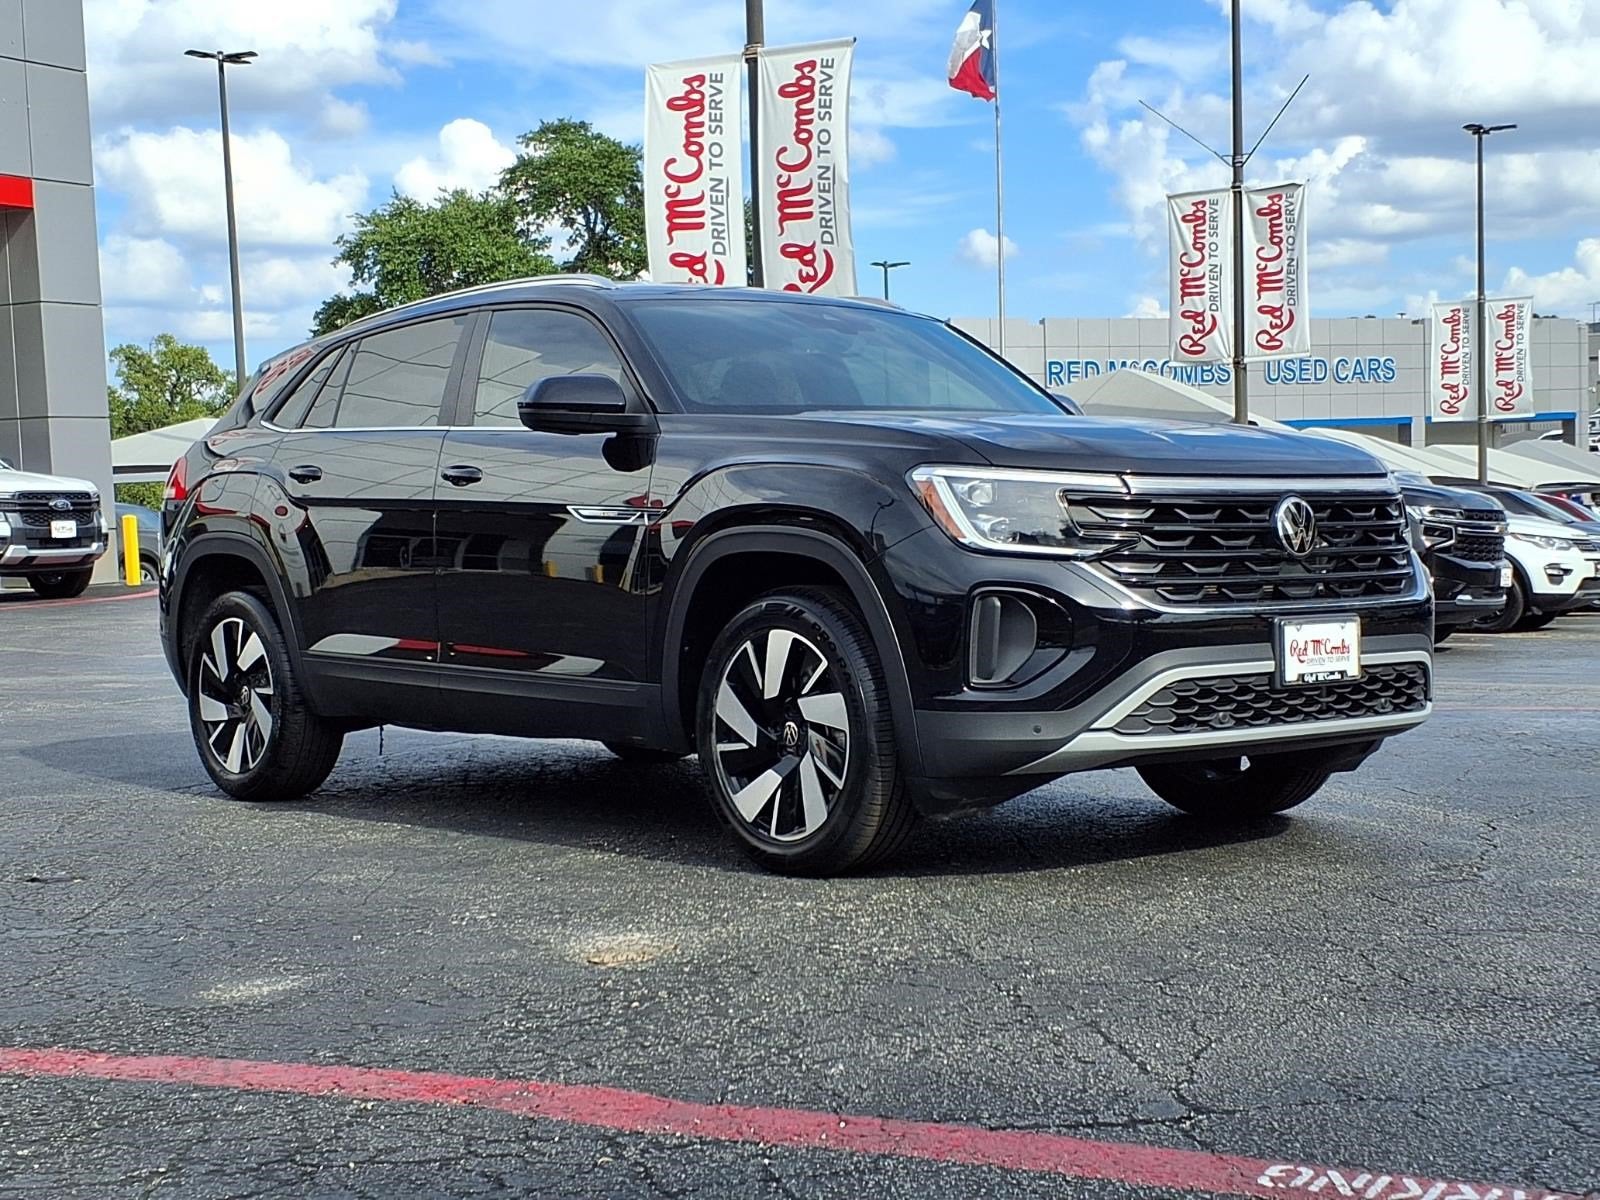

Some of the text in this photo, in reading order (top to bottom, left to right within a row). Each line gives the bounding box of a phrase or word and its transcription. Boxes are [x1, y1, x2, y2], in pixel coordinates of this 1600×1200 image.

[664, 74, 706, 246] McCombs
[708, 72, 727, 256] DRIVEN TO SERVE
[776, 59, 817, 237] McCombs
[817, 57, 835, 246] DRIVEN TO SERVE
[1179, 200, 1217, 356] Red McCombs
[1208, 198, 1219, 313] DRIVEN TO SERVE
[1255, 193, 1295, 351] Red McCombs
[1285, 192, 1296, 306] DRIVEN TO SERVE
[1048, 361, 1100, 386] RED
[1266, 358, 1328, 384] USED
[1334, 358, 1396, 383] CARS
[1440, 308, 1468, 415] Red McCombs
[1462, 307, 1470, 385] DRIVEN TO SERVE
[1495, 304, 1523, 412] Red McCombs
[1516, 303, 1525, 382] DRIVEN TO SERVE
[812, 622, 836, 652] PRO
[1290, 638, 1350, 663] Red McCombs
